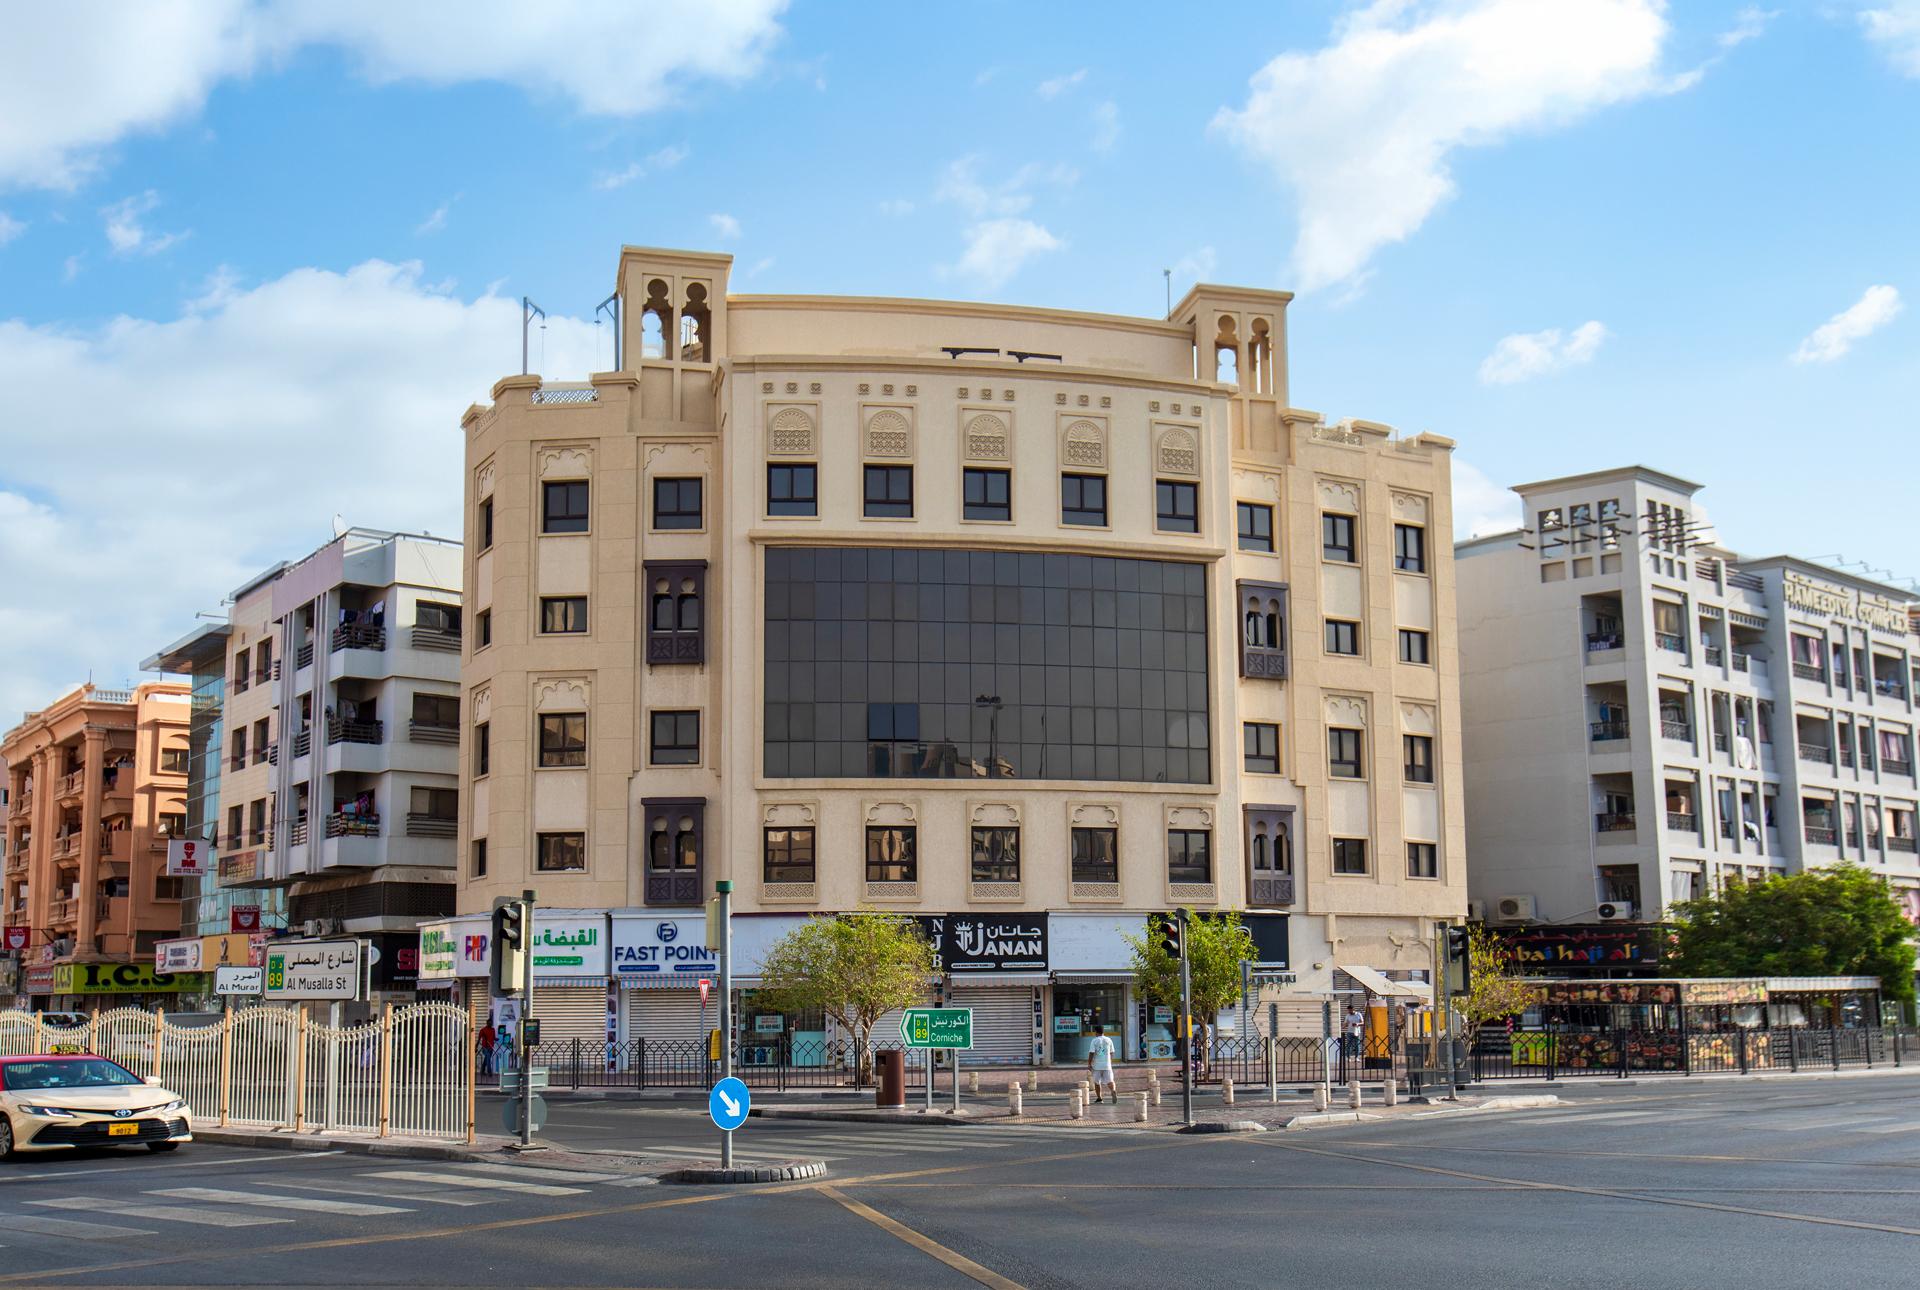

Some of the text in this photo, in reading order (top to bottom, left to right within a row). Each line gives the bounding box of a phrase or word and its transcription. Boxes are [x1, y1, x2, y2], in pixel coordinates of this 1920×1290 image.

[543, 928, 597, 950] القبضة
[986, 925, 1041, 939] جانان
[614, 946, 659, 961] FAST
[1610, 943, 1640, 961] ali
[288, 950, 355, 970] شارع المصلى
[233, 970, 260, 981] المرر
[269, 973, 283, 987] 89
[287, 977, 347, 990] Al Musalla St
[931, 1015, 969, 1028] الكورنيش
[915, 1028, 928, 1038] 89
[930, 1032, 963, 1043] Corniche
